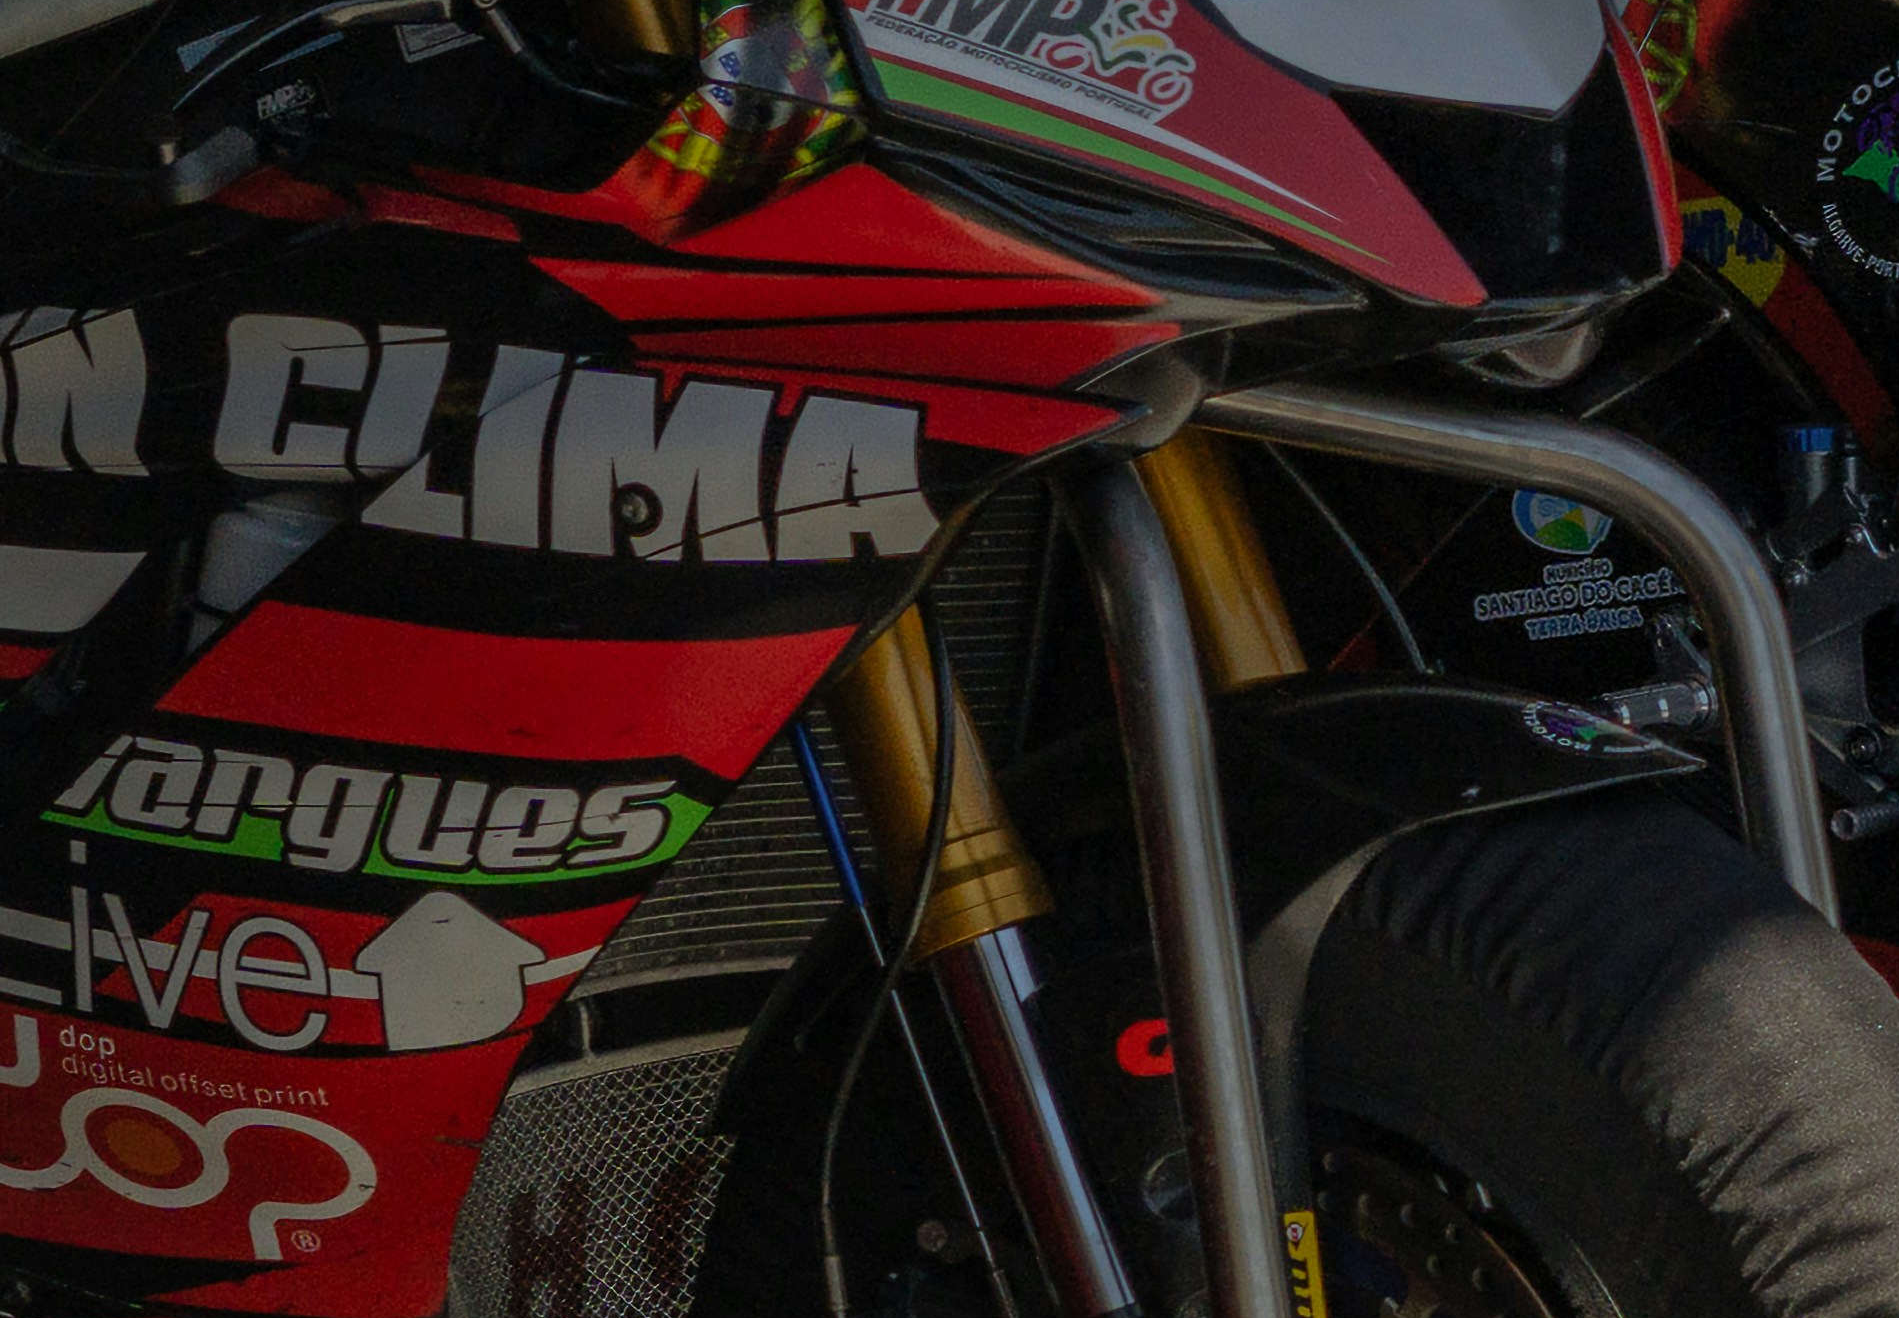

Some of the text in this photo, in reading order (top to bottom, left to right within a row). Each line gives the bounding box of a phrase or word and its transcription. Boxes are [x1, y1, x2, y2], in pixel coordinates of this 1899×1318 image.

[866, 14, 1154, 121] FEDERAÇÃO MOTOCICLISMO PORTUGAL
[0, 305, 942, 564] N CLIMA
[1474, 585, 1578, 621] SANTIAGO
[1579, 580, 1614, 607] DO
[59, 1024, 117, 1060] dop
[62, 1054, 331, 1108] digital offset print
